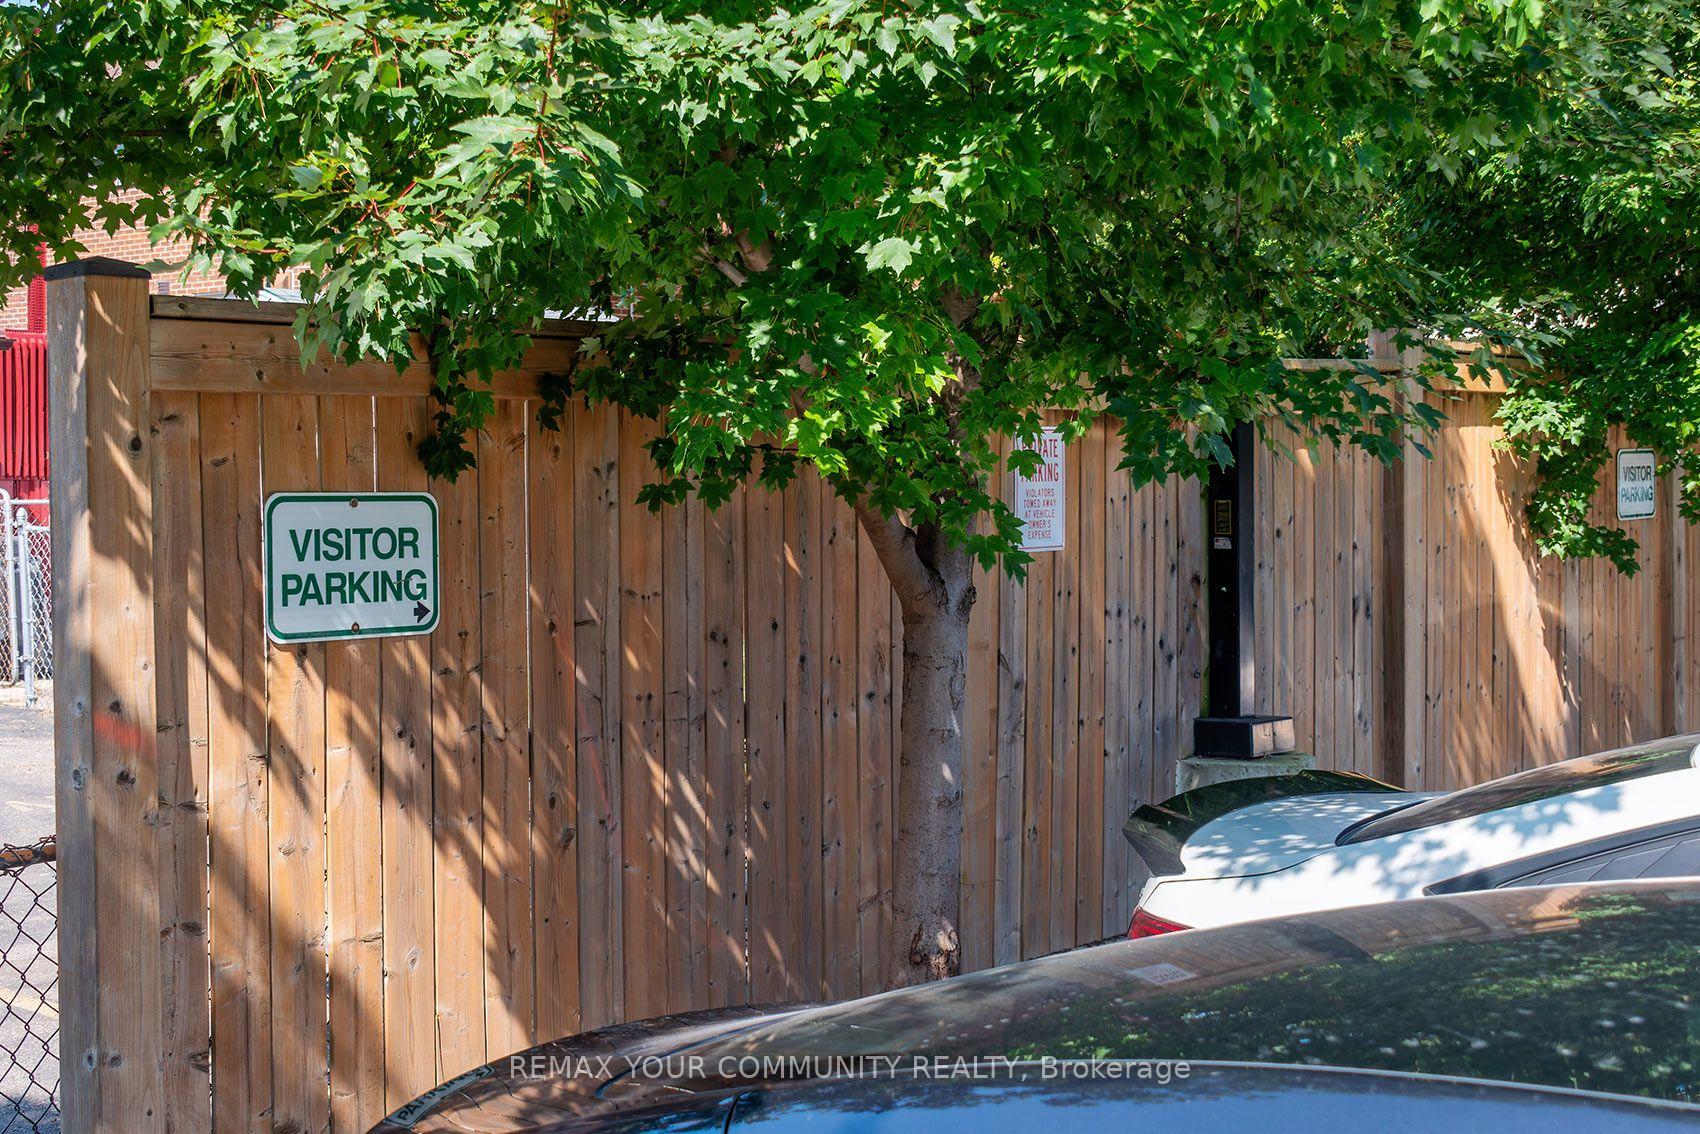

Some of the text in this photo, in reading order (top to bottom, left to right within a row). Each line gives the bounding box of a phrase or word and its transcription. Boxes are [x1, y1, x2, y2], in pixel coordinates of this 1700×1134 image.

[1623, 466, 1652, 482] VISITOR
[1025, 488, 1055, 498] VIOLATORS
[1621, 486, 1653, 503] PARKING
[1024, 498, 1056, 508] TOWED AWAY
[1025, 509, 1055, 518] AT VEHICLE
[1028, 530, 1052, 540] EXPENSE
[289, 526, 420, 562] VISITOR
[281, 568, 427, 607] PARKING
